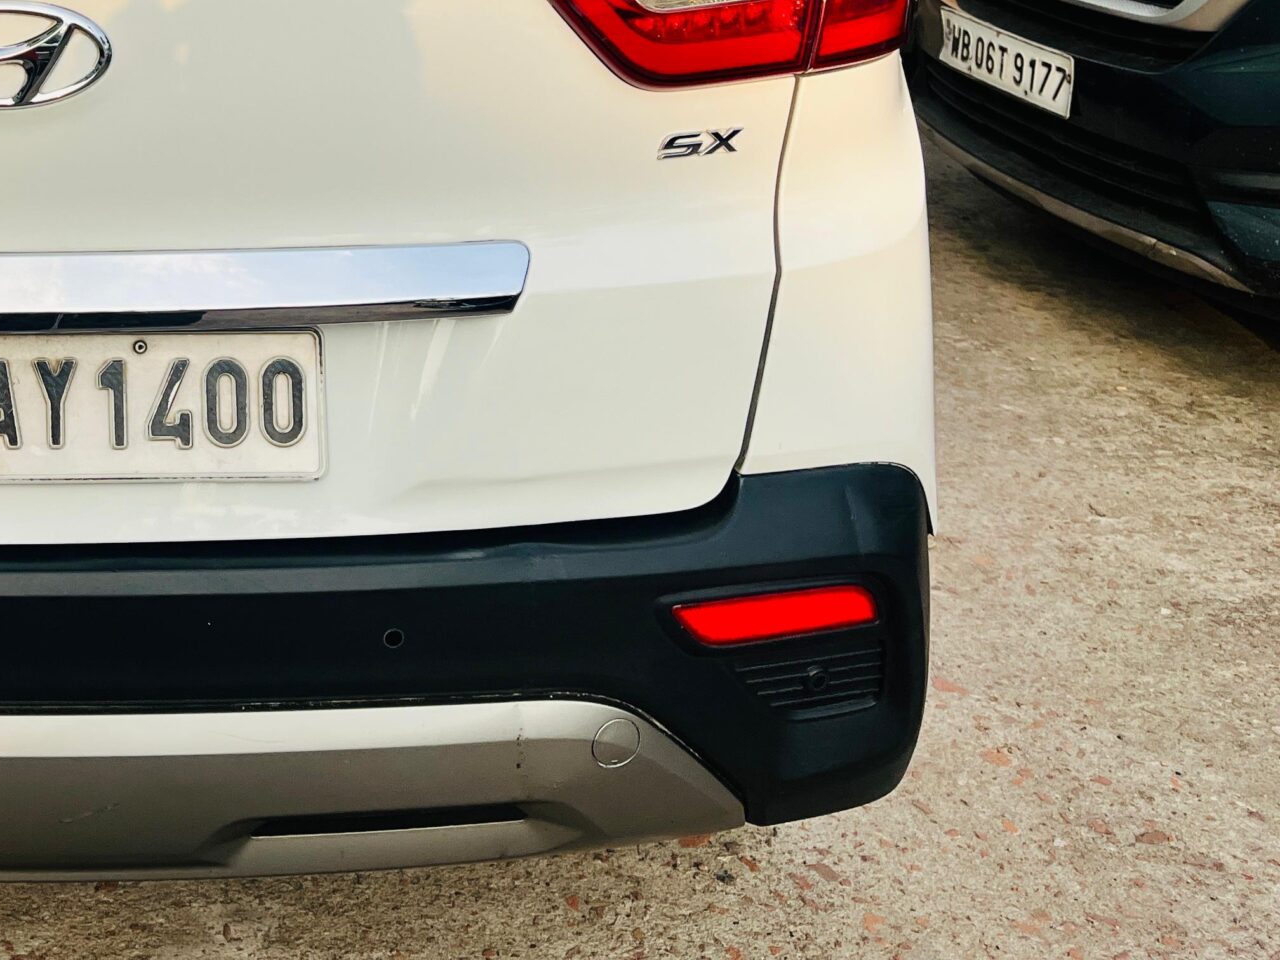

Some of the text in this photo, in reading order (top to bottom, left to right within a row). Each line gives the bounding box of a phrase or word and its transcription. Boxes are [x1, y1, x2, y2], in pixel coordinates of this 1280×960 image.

[951, 24, 971, 62] WB
[1012, 52, 1067, 102] 9177
[657, 127, 744, 160] SX
